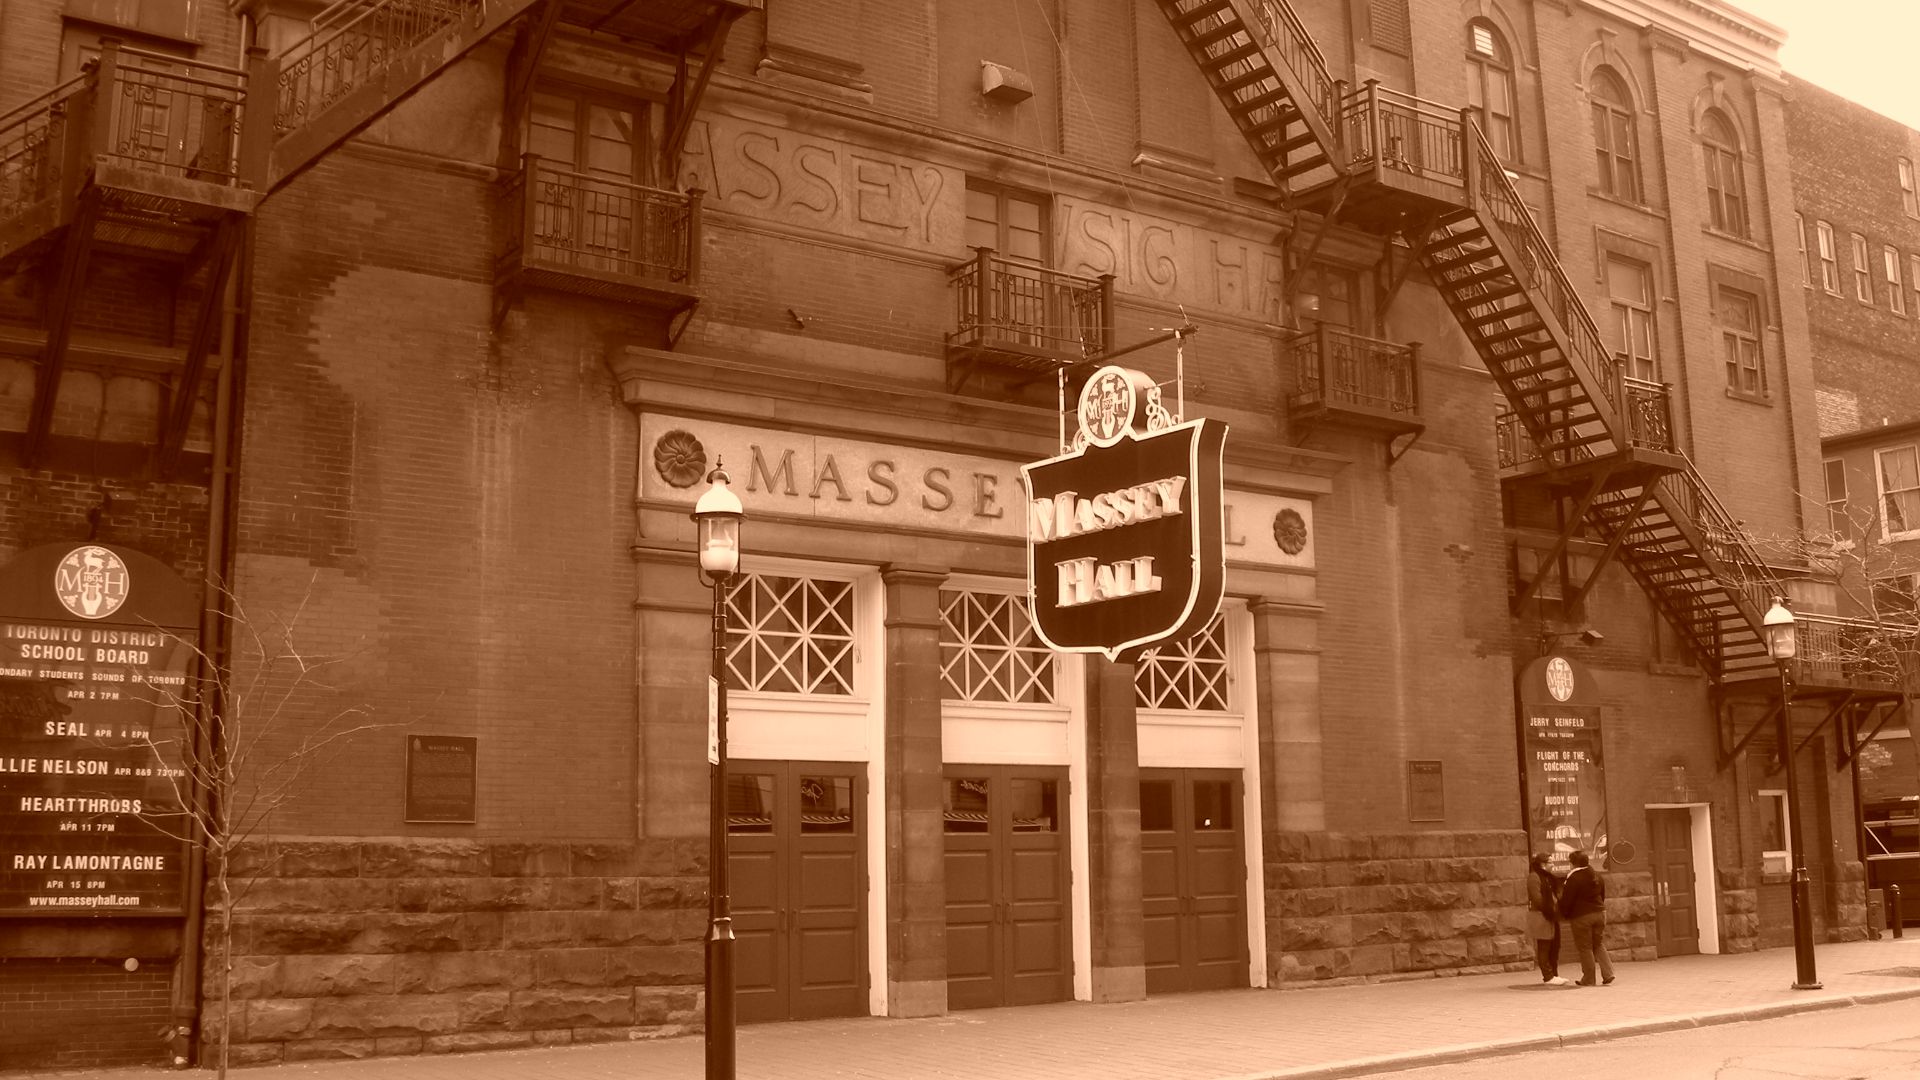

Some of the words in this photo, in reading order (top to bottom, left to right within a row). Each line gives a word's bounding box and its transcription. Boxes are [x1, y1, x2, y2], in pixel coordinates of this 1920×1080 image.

[1030, 476, 1187, 544] MASSEY
[1054, 556, 1162, 608] HALL
[6, 625, 82, 642] TORONTO
[91, 630, 166, 647] DISTRICT
[21, 644, 85, 661] SCHOOL
[96, 649, 149, 665] BOARD
[0, 668, 32, 677] ONDARY
[40, 670, 84, 680] STUDENTS
[92, 673, 125, 682] SOUNDS
[131, 675, 143, 683] OF
[148, 675, 186, 685] TORONTO
[67, 690, 85, 699] APR
[89, 691, 96, 699] 2
[101, 692, 119, 700] 7PM
[45, 721, 88, 737] SEAL
[94, 729, 112, 738] APR
[121, 730, 127, 738] 4
[1530, 717, 1549, 727] JERRY
[1554, 718, 1585, 727] SEINFELD
[1536, 751, 1559, 760] FLIGHT
[1562, 751, 1571, 760] OF
[1573, 751, 1585, 760] THE
[0, 758, 37, 773] LLIE
[42, 759, 108, 775] NELSON
[114, 768, 131, 776] APR
[135, 768, 151, 777] 8&9
[1543, 762, 1579, 771] CONCHORDS
[20, 797, 142, 814] HEARTTHROBS
[1545, 795, 1564, 805] BUDDY
[1567, 795, 1579, 805] GUY
[60, 823, 77, 832] APR
[81, 824, 92, 832] 11
[97, 824, 115, 832] 7PM
[14, 855, 48, 870] RAY
[52, 855, 164, 870] LAMONTAGNE
[46, 880, 64, 889] APR
[70, 881, 81, 889] 15
[87, 881, 106, 889] 8PM
[29, 894, 140, 907] www.masseyhall.com
